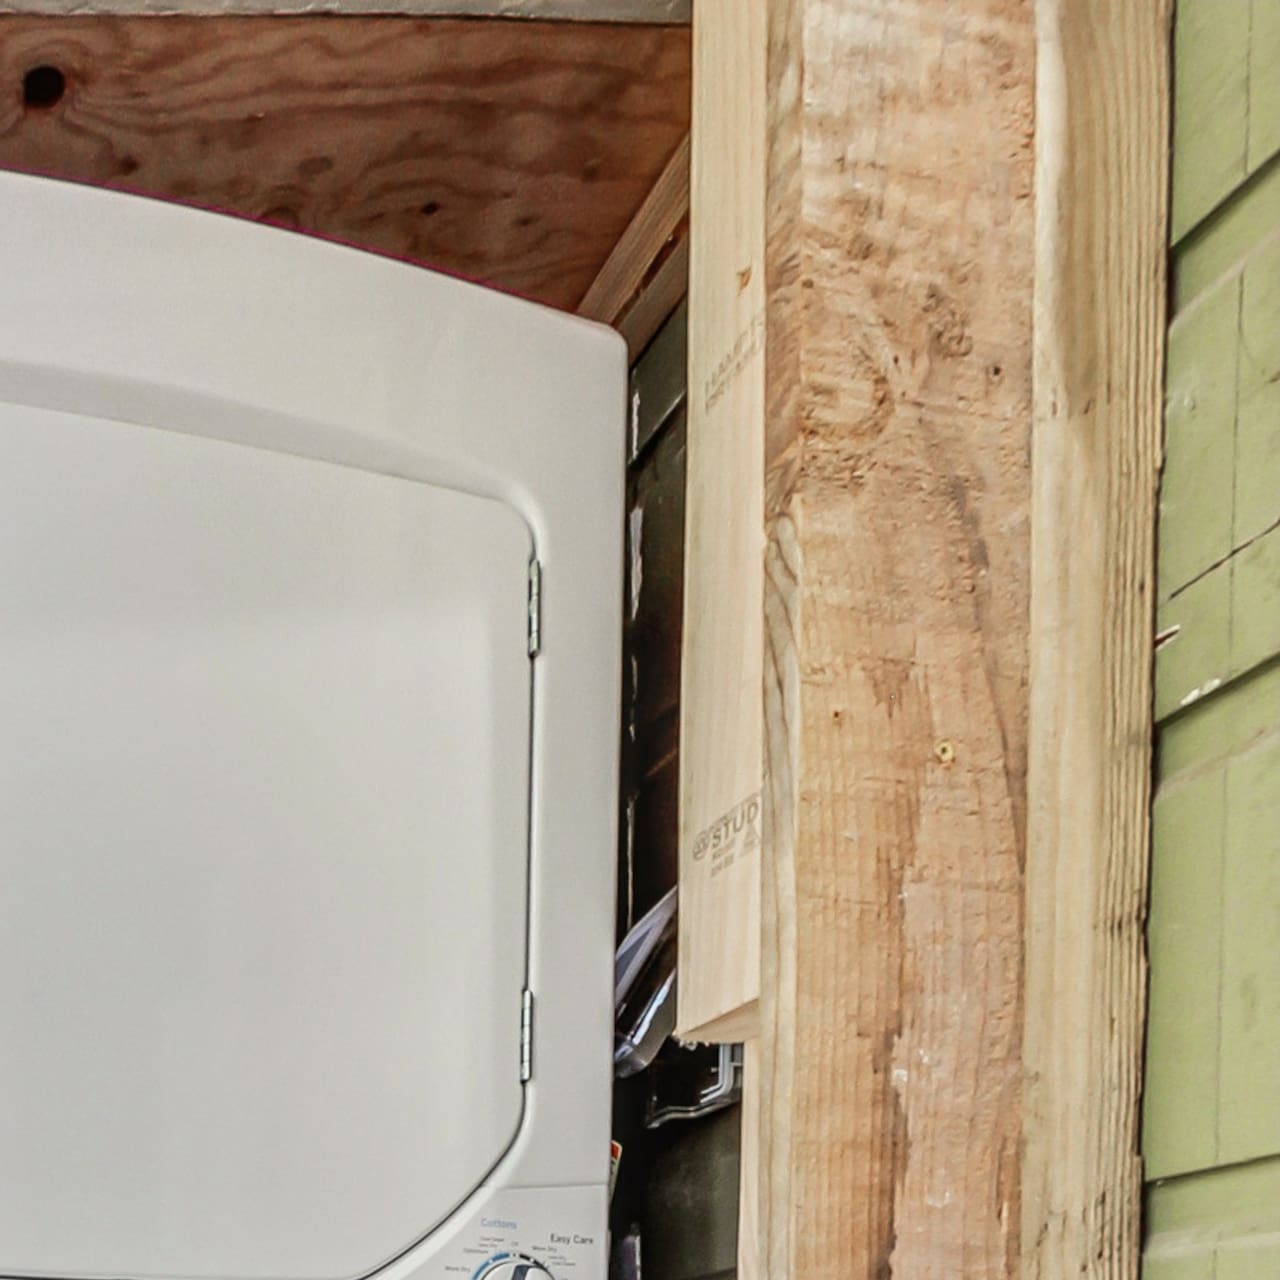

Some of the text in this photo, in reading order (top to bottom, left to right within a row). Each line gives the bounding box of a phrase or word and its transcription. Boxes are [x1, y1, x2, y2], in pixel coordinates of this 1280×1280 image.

[713, 801, 758, 849] STUD
[550, 1234, 593, 1244] Easy Care
